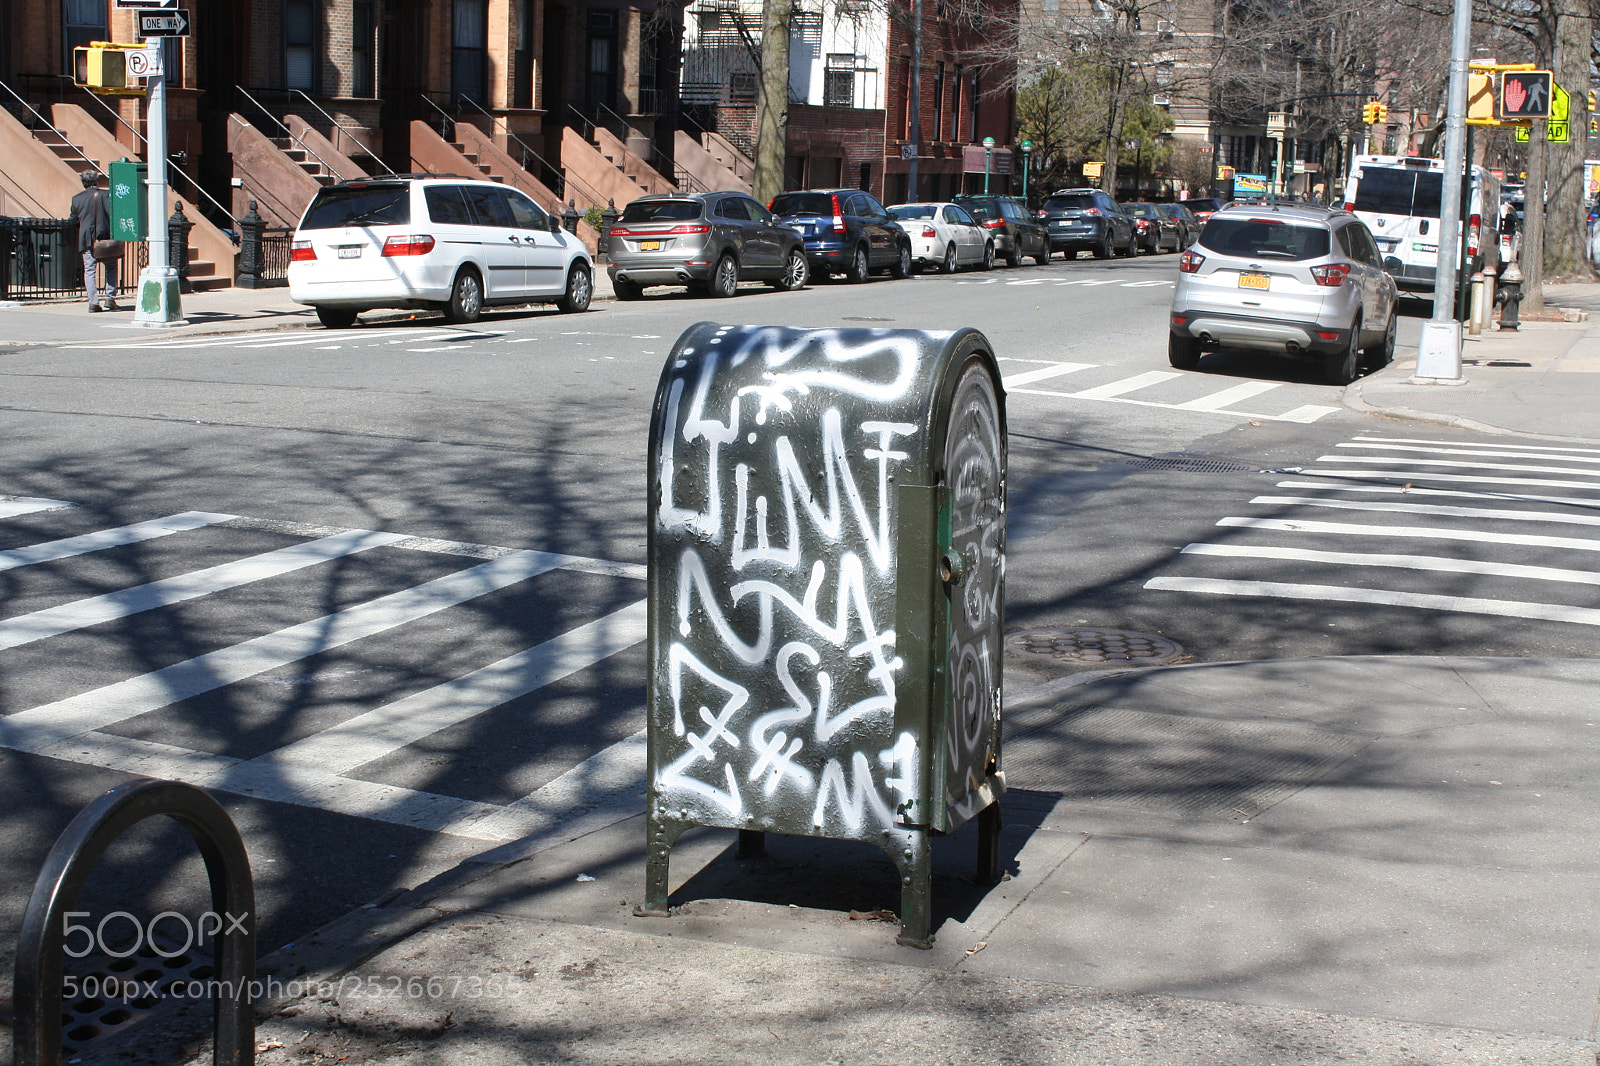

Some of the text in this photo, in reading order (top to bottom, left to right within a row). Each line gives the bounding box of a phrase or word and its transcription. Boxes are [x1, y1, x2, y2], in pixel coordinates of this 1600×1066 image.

[146, 18, 182, 29] ONE WAY
[1523, 126, 1563, 138] AAD
